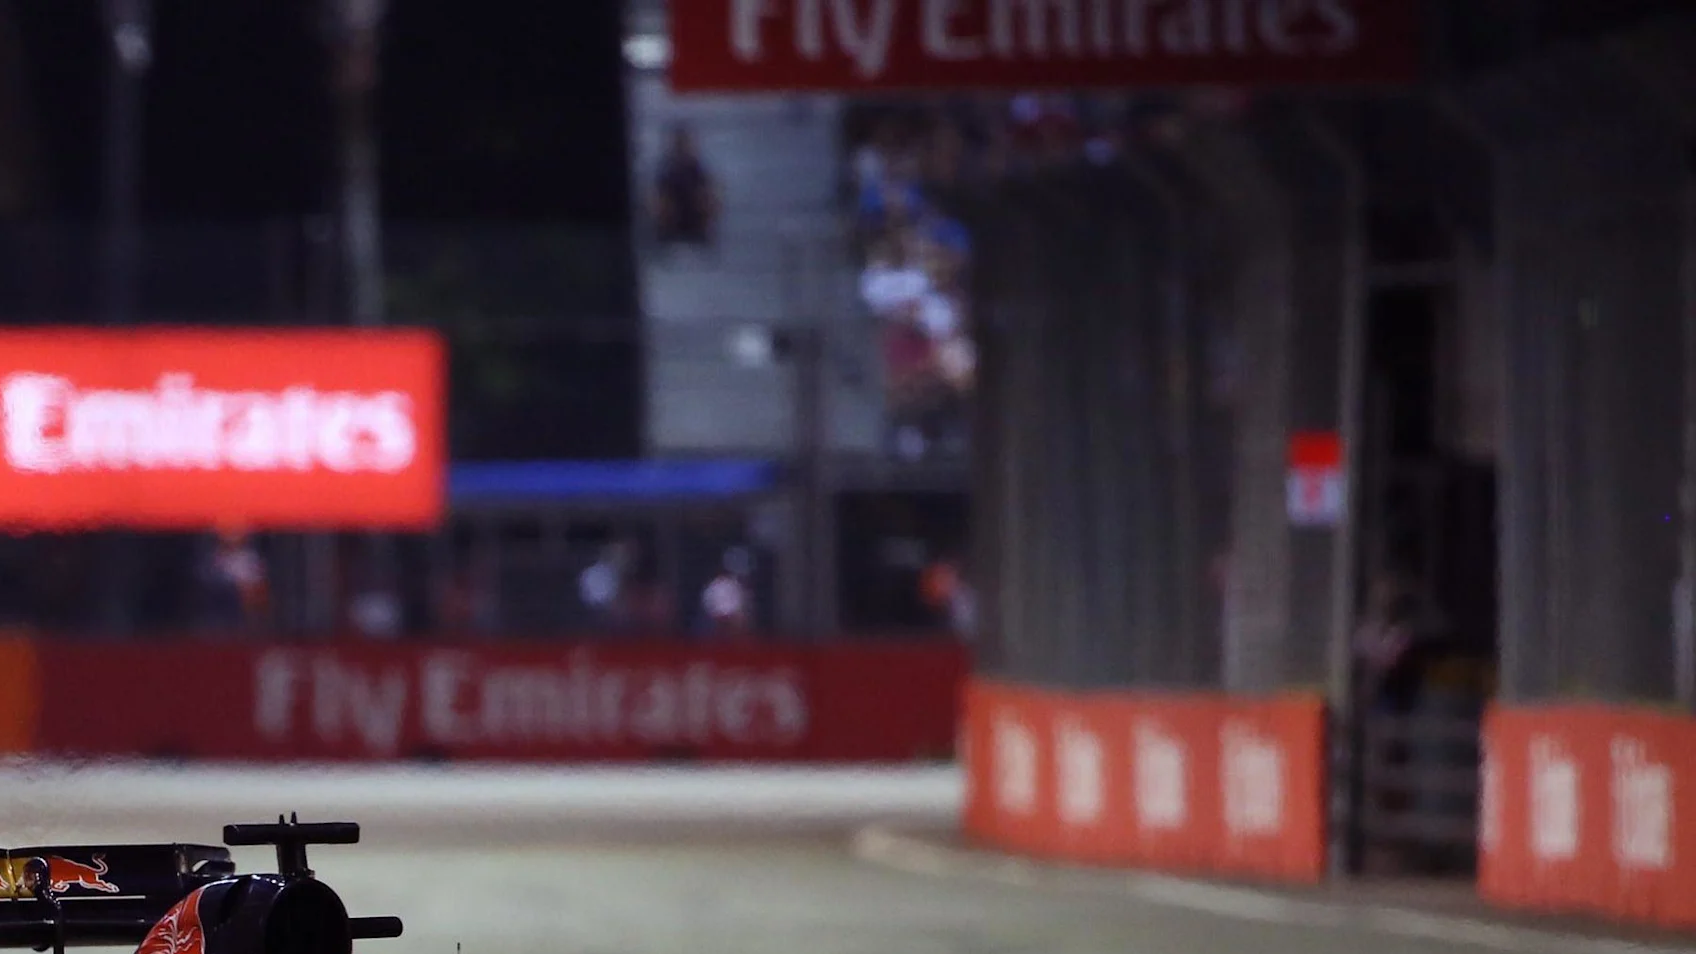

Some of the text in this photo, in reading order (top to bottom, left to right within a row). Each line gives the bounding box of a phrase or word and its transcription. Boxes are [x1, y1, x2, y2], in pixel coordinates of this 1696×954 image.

[2, 371, 416, 473] Emirates
[254, 648, 806, 751] Fly Emirates
